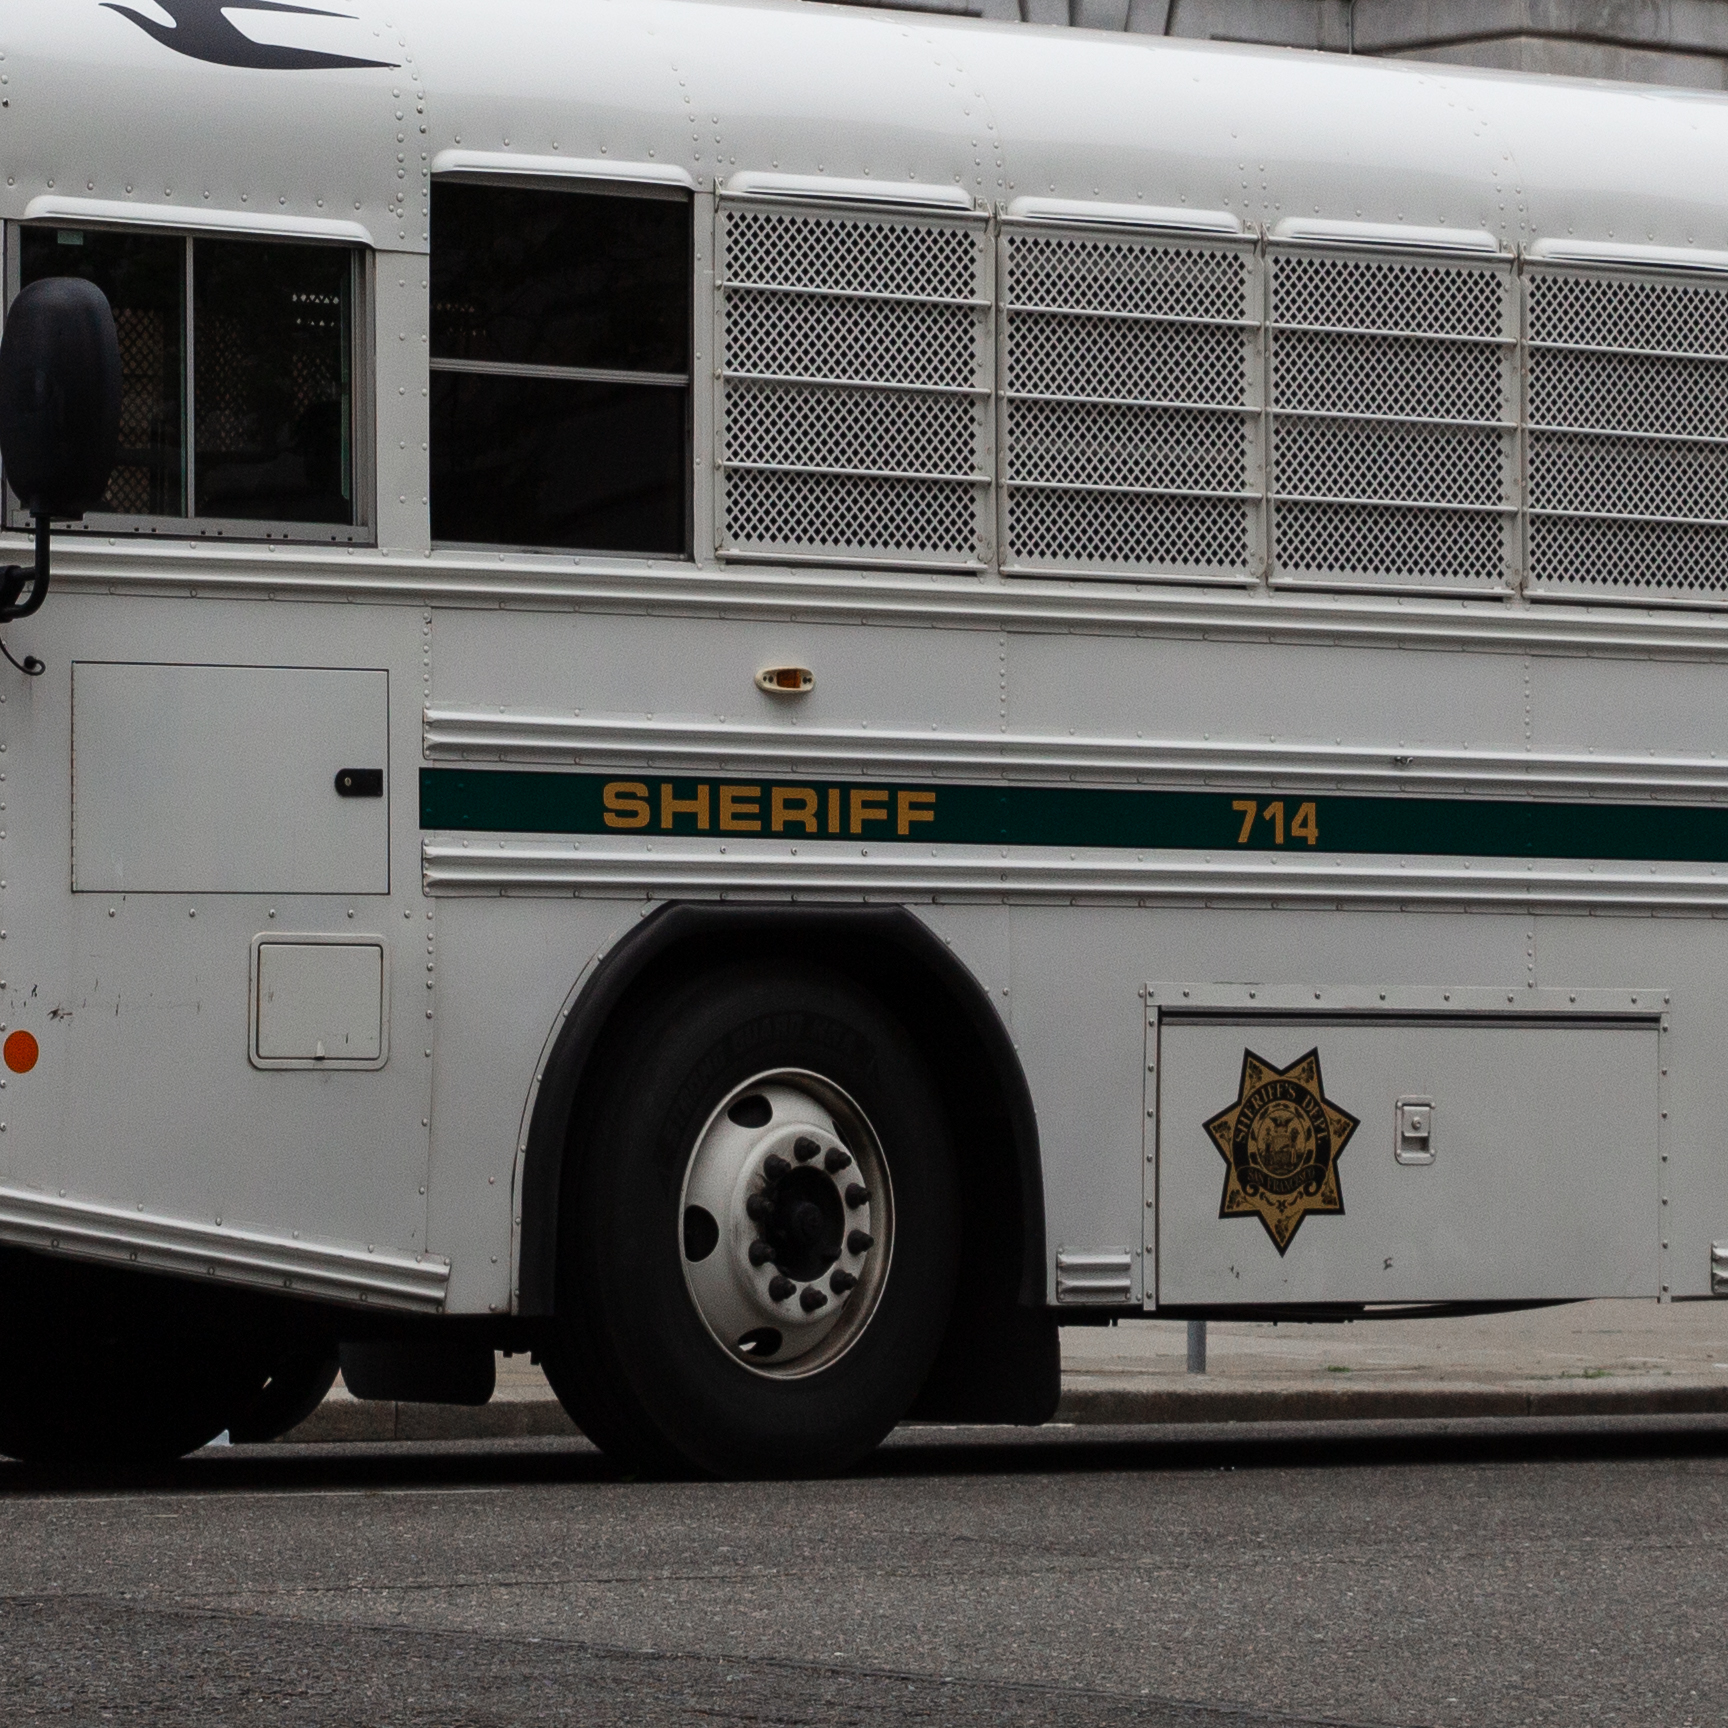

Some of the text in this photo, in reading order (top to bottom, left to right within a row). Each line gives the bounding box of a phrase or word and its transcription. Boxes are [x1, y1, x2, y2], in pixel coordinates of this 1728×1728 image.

[602, 782, 1319, 846] SHERIFF 714
[1235, 1084, 1296, 1144] SHERIFF'S
